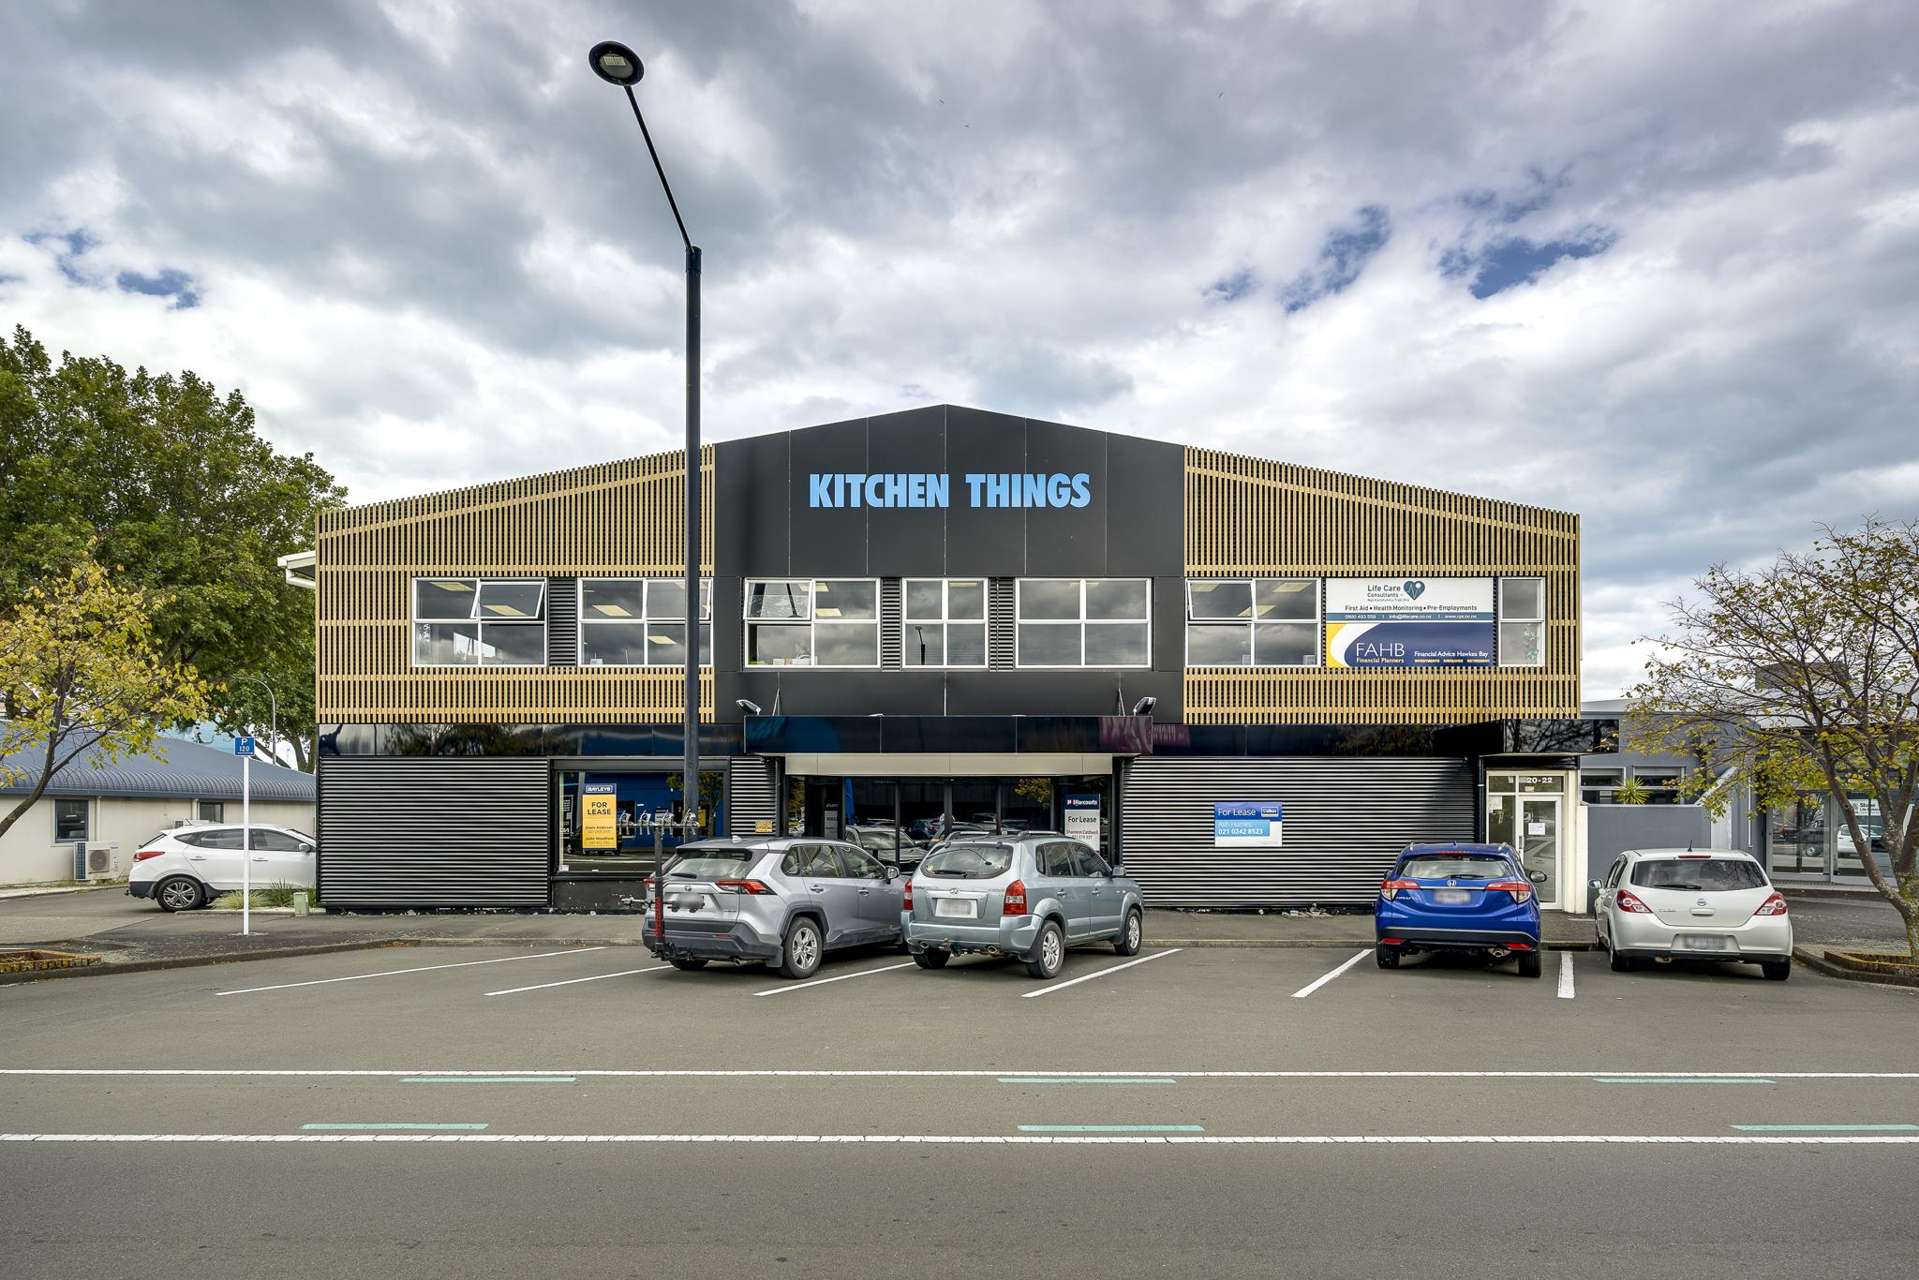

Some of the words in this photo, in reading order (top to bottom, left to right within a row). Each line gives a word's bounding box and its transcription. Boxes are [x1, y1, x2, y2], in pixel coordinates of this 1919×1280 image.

[809, 473, 949, 508] KITCHEN
[965, 473, 1091, 508] THINGS
[1367, 584, 1382, 592] Life
[1383, 584, 1401, 592] Care
[1356, 643, 1405, 657] FAHB
[1478, 650, 1489, 658] Bay
[1218, 808, 1231, 816] For
[1233, 808, 1256, 816] Lease
